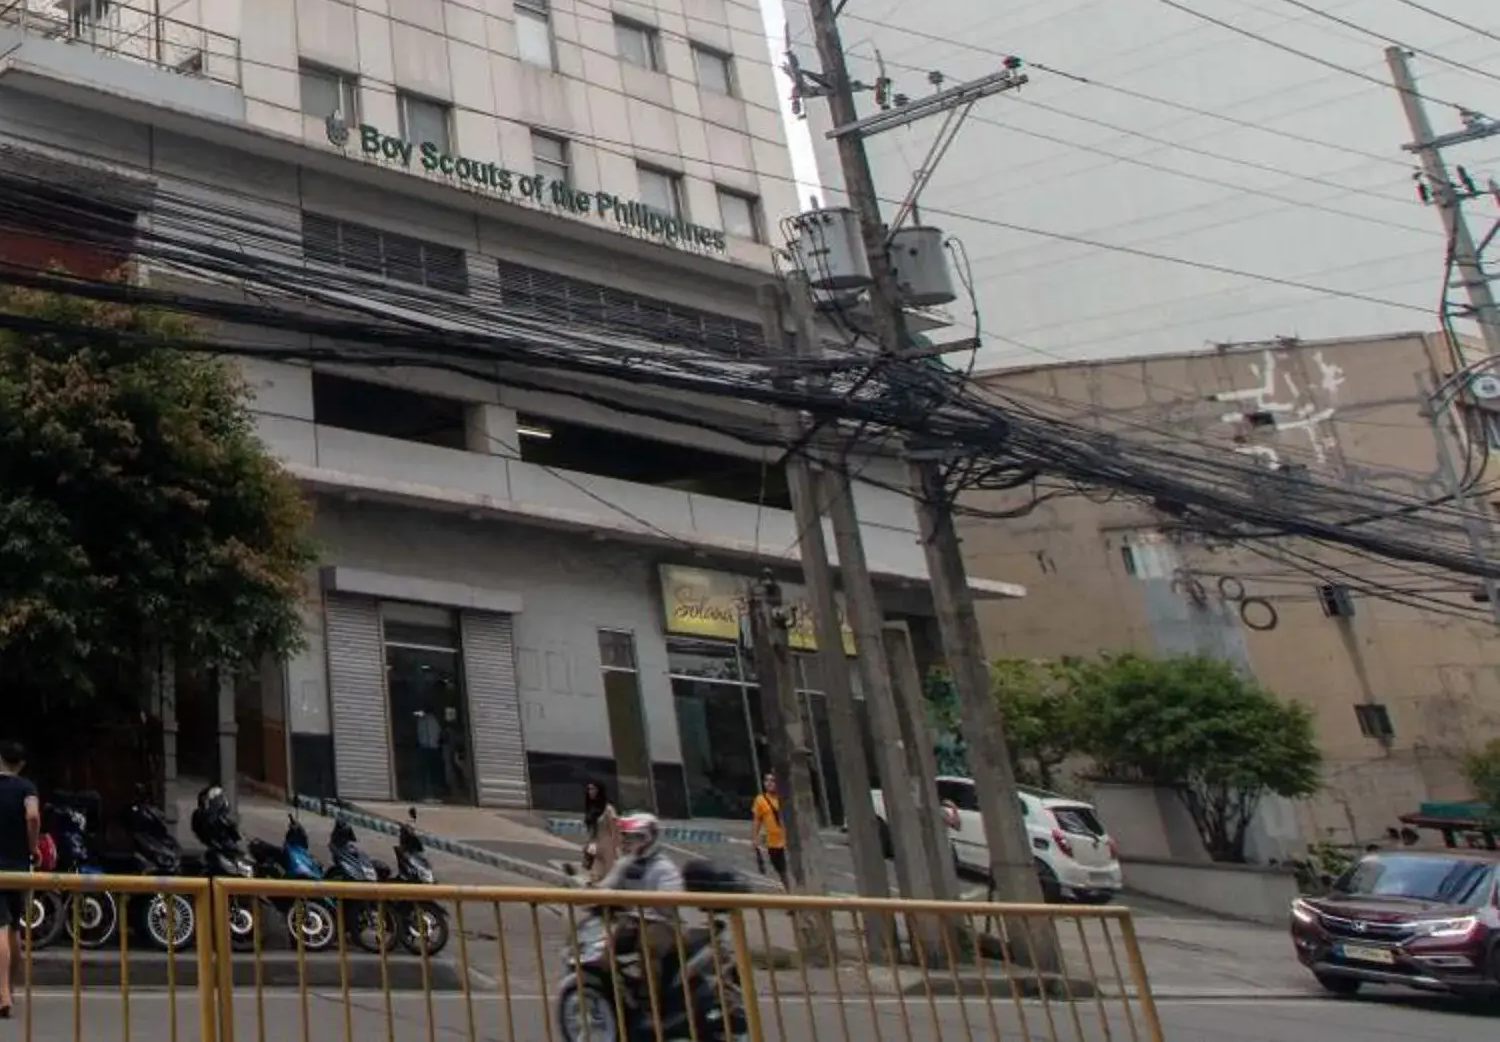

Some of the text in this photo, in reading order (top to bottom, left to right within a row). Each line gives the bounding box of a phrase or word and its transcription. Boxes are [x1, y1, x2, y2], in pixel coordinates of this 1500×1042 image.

[360, 123, 726, 249] Boy Scouts of the Philippines
